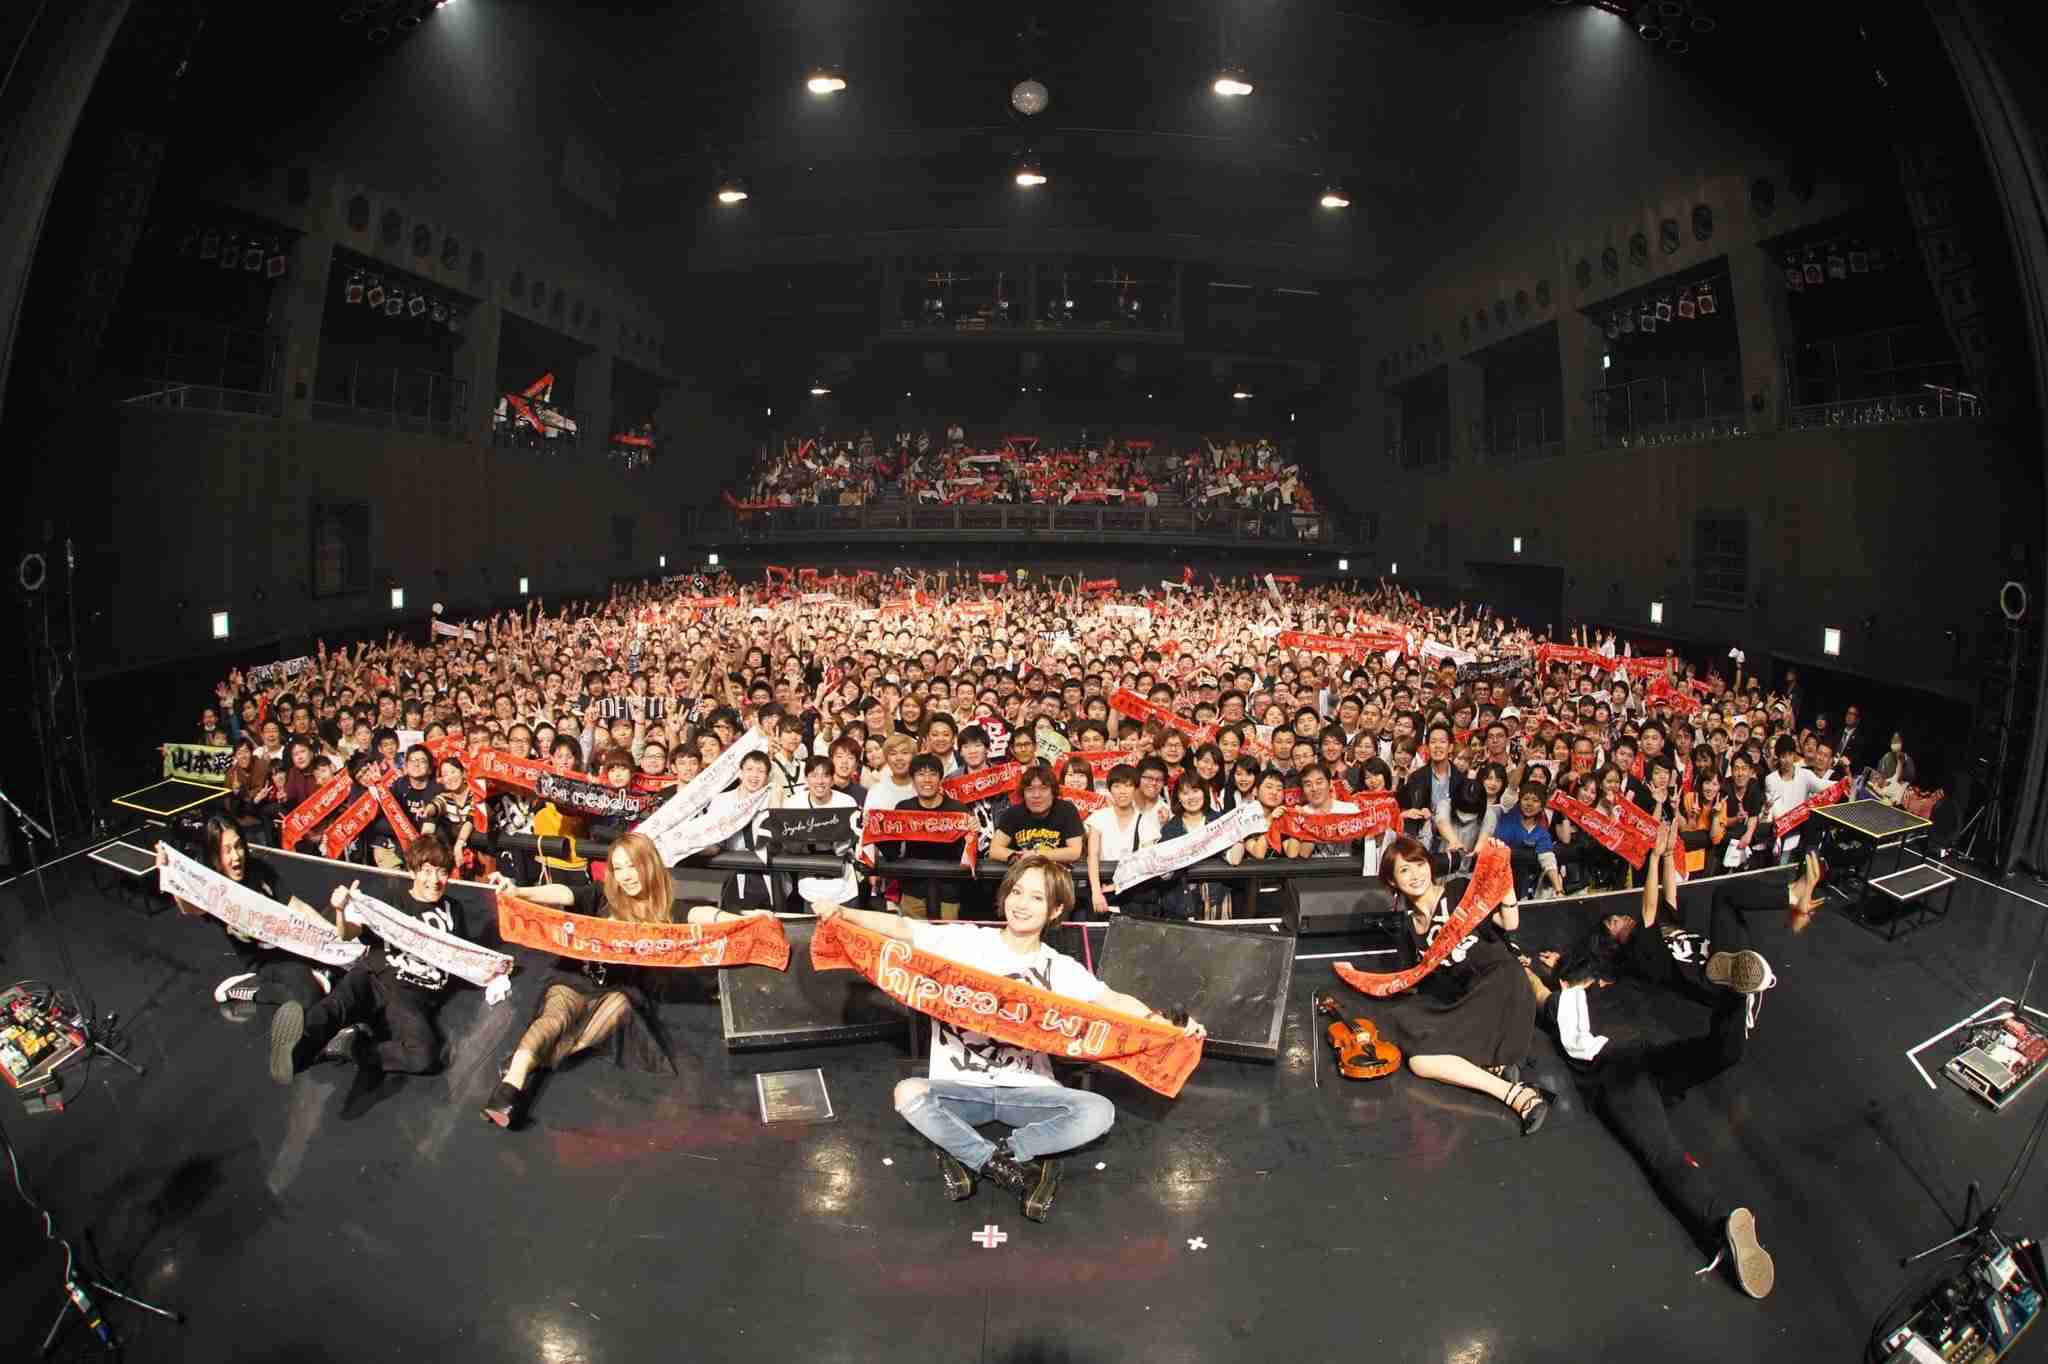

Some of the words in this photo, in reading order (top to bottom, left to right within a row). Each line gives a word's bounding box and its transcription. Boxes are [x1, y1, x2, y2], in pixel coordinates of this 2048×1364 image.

[911, 813, 975, 834] read
[878, 940, 1029, 1022] ready
[1041, 1008, 1112, 1056] I'm
